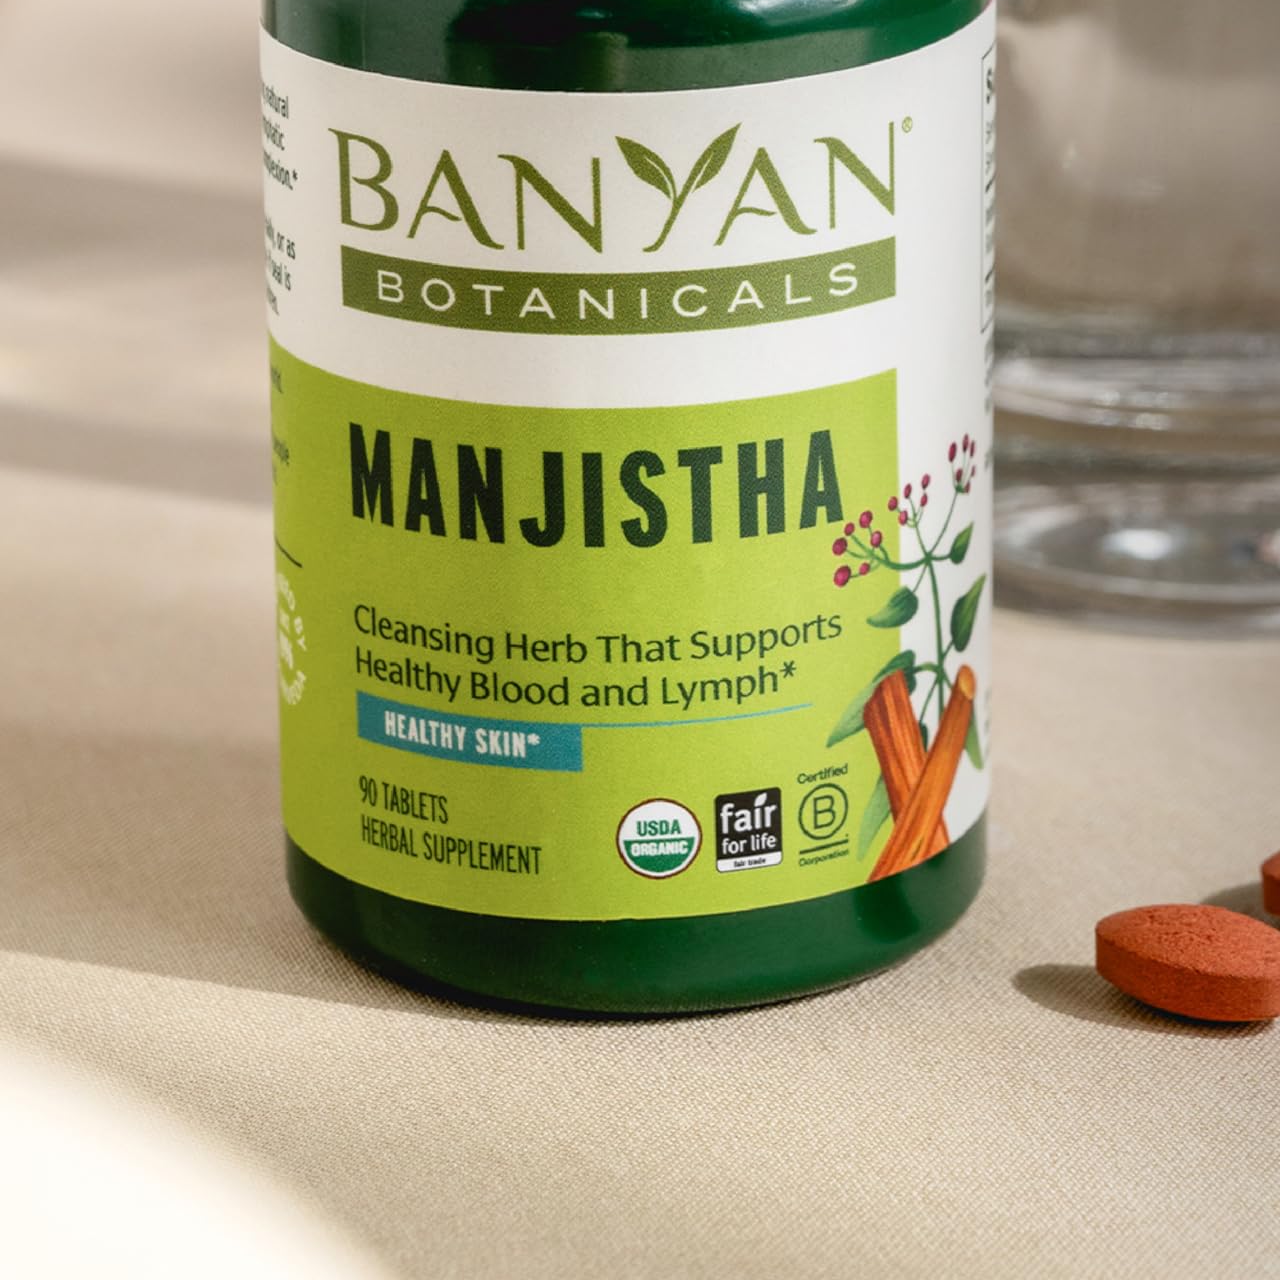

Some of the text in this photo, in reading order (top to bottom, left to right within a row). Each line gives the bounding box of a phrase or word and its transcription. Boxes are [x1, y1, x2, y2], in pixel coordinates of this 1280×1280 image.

[376, 262, 859, 320] BOTANICALS
[349, 422, 844, 548] MANJISTHA
[354, 604, 843, 664] Cleansing Herb That Supports
[356, 646, 461, 703] Healthy
[470, 671, 570, 706] Blood
[580, 676, 648, 707] and
[384, 710, 467, 751] HEALTHY
[797, 763, 849, 785] Certified
[359, 775, 449, 825] 90 TABLETS
[720, 793, 778, 835] fair
[361, 814, 543, 875] HERBAL SUPPLEMENT
[630, 836, 689, 856] ORGANIC
[636, 819, 682, 837] USDA
[721, 833, 777, 855] for life
[798, 848, 850, 867] Corporation
